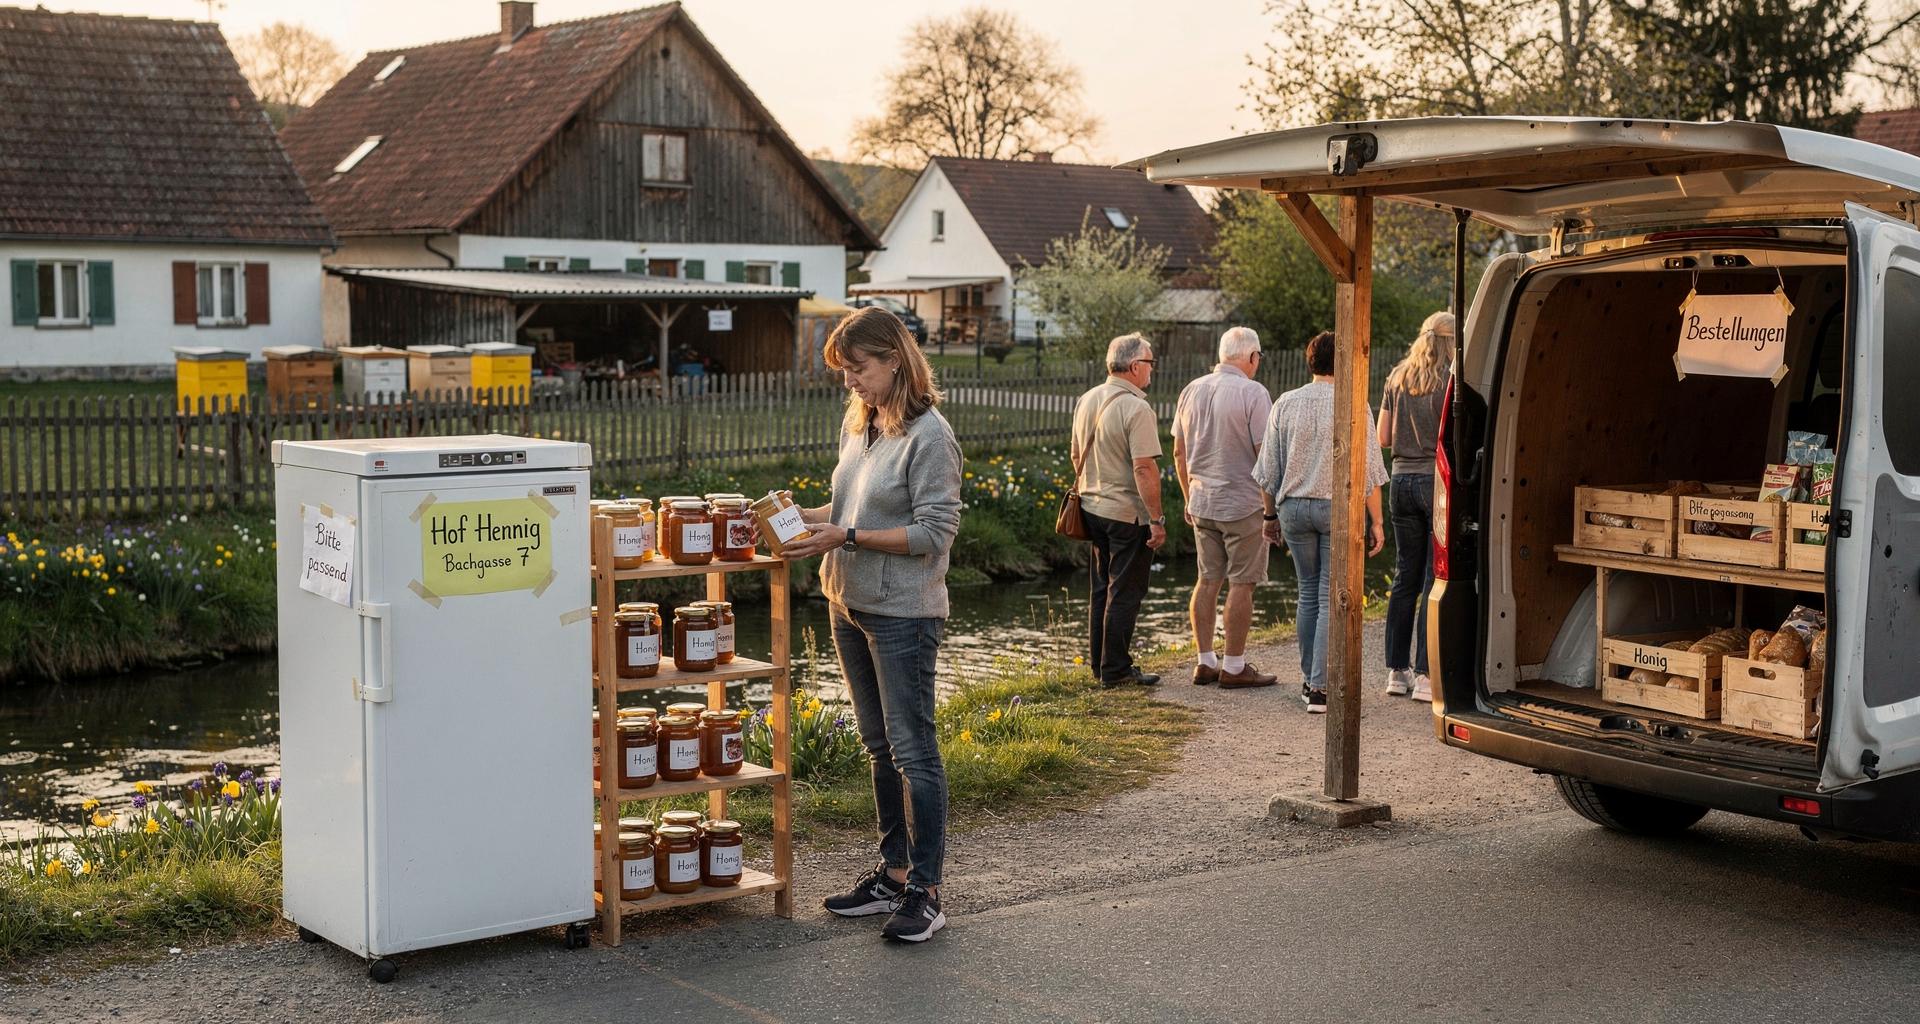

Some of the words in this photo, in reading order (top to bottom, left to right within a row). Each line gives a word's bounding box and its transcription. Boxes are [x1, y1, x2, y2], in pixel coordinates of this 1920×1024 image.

[1686, 314, 1785, 352] Bestellungen
[315, 522, 341, 551] Bitte
[431, 514, 468, 545] Hof
[474, 513, 541, 550] Hennig
[688, 529, 711, 546] Honig
[306, 557, 348, 582] passend
[442, 552, 512, 579] Bachgasse
[517, 546, 529, 566] 7
[692, 636, 715, 652] Honig
[1634, 647, 1668, 673] Honig
[715, 852, 740, 867] Honig
